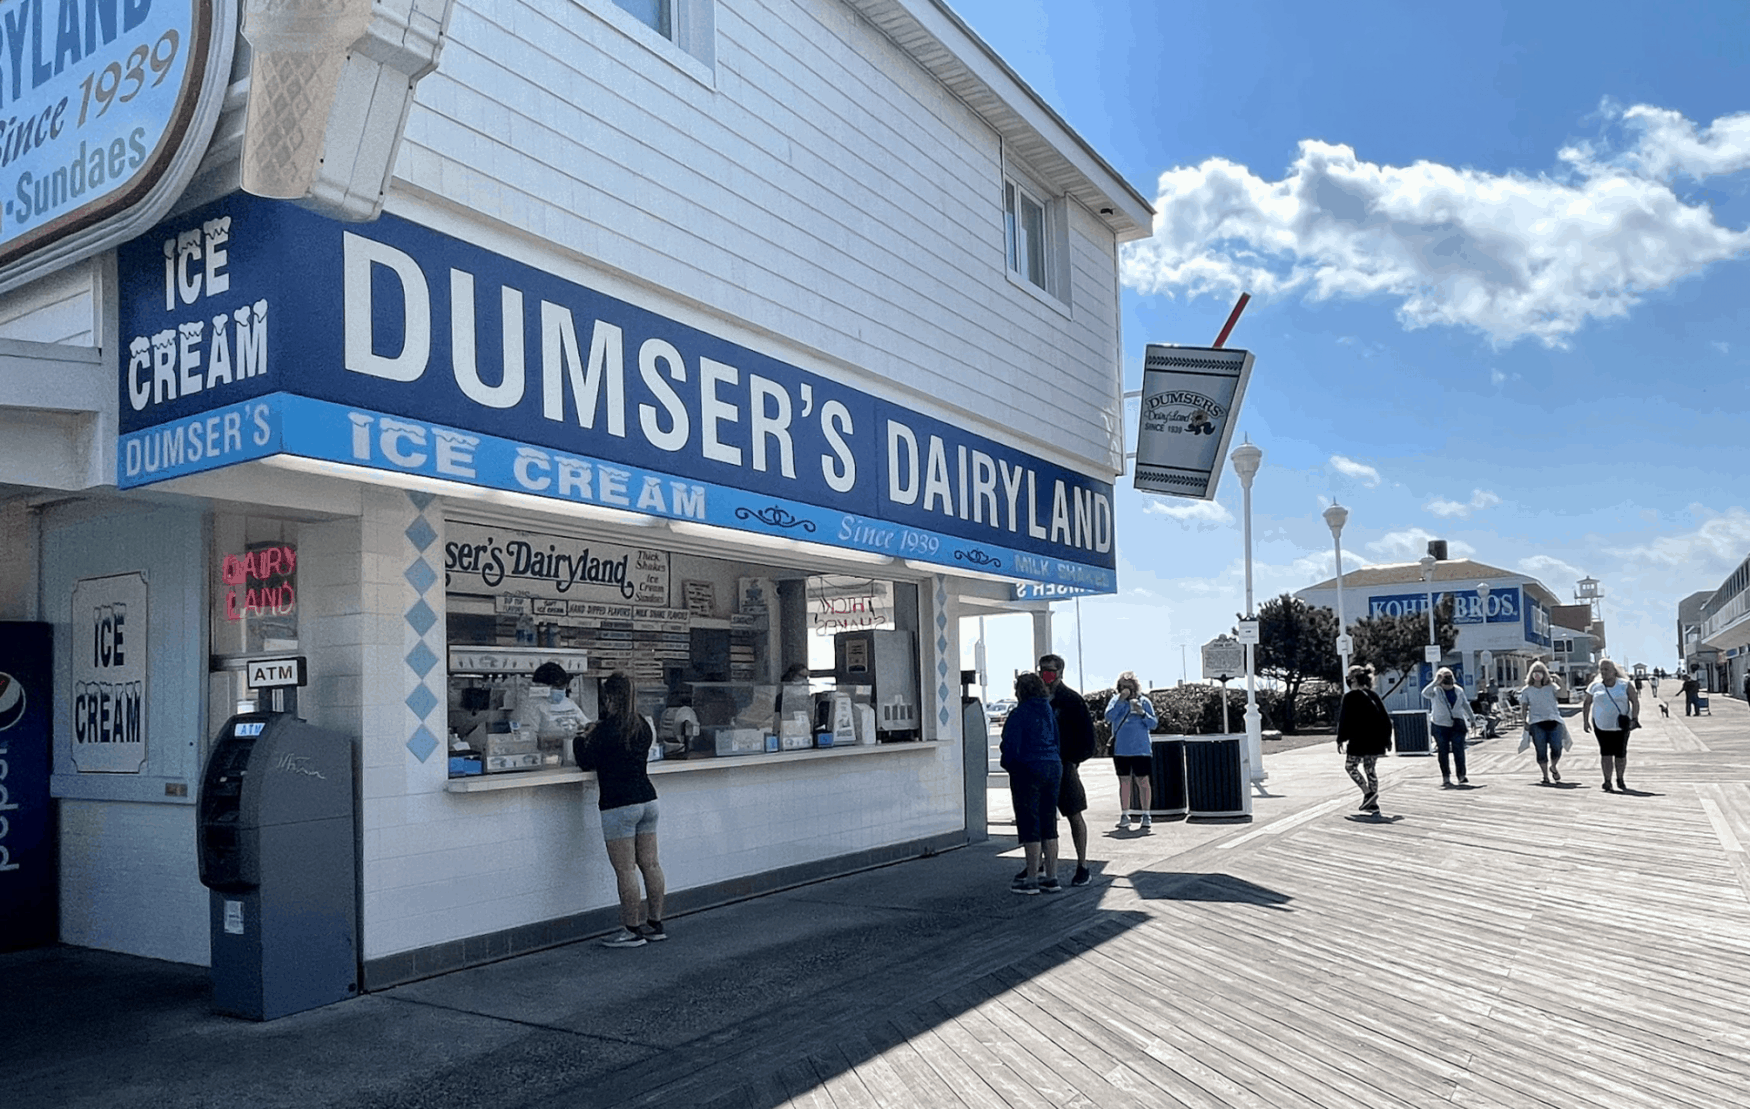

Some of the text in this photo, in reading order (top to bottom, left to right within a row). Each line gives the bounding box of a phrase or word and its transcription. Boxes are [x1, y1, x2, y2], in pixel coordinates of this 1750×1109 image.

[77, 28, 180, 130] 1939
[163, 216, 231, 311] ICE
[127, 299, 269, 411] CREAM
[343, 231, 1112, 555] DUMSER'S DAIRYLAND
[125, 403, 271, 478] DUMSER'S
[1145, 422, 1183, 434] SINCE 1939
[347, 411, 706, 520] ICE CREAM
[837, 515, 941, 556] Since 1939
[222, 546, 297, 585] DAIRY
[445, 536, 505, 587] ser's
[506, 541, 635, 599] Dairyland
[635, 559, 666, 573] Shakes
[638, 550, 661, 562] Thick
[1014, 554, 1050, 577] MILK
[639, 582, 665, 593] Cream
[646, 574, 659, 584] Ice
[226, 581, 295, 620] LAND
[1453, 593, 1518, 618] BROS.
[93, 602, 127, 668] ICE
[254, 665, 293, 682] ATM
[75, 680, 142, 744] CREAM
[240, 723, 264, 736] ATM
